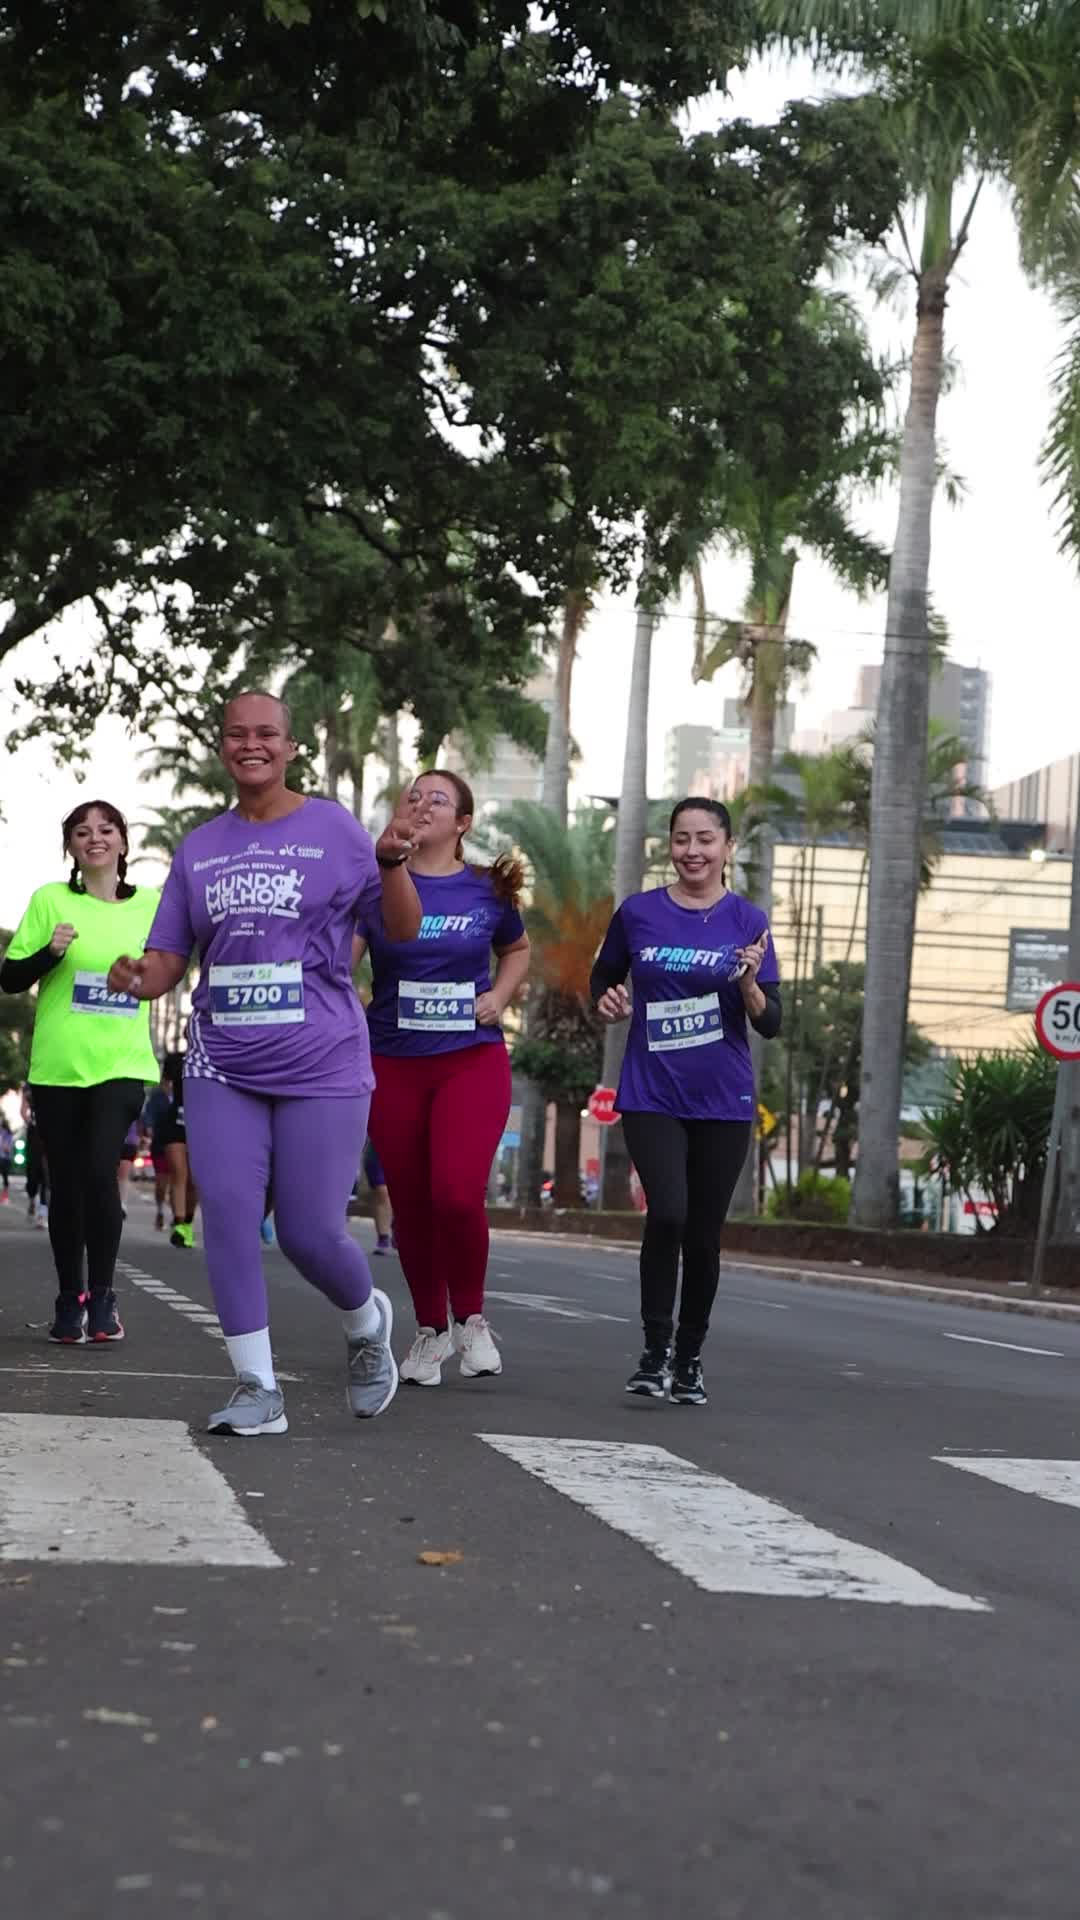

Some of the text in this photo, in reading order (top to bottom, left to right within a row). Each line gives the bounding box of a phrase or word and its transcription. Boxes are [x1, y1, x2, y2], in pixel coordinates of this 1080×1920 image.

[206, 872, 287, 902] MUNDO
[207, 887, 288, 915] MELHOR
[229, 905, 267, 915] RUNNING
[664, 963, 690, 973] RUN
[227, 985, 282, 1005] 5700
[414, 1000, 459, 1014] 5664
[661, 1014, 705, 1034] 6189
[592, 1099, 614, 1113] PAR
